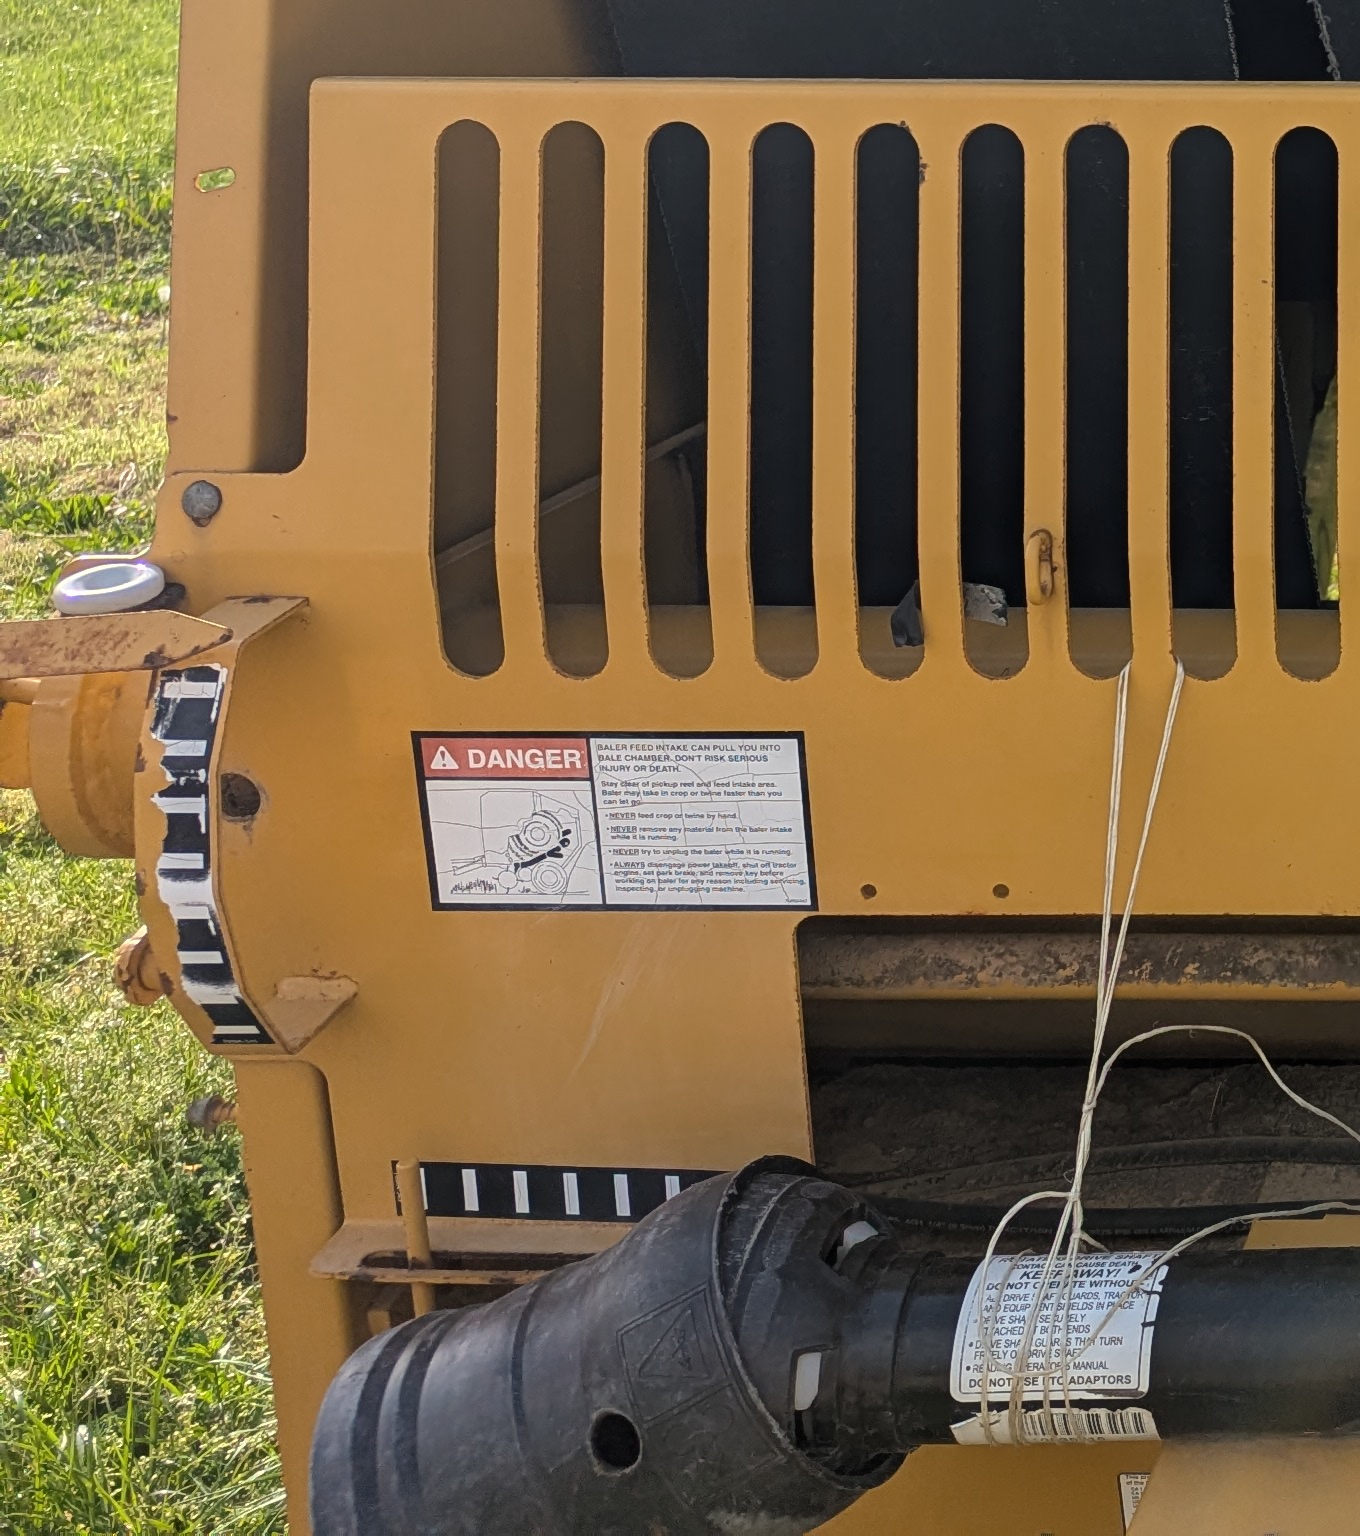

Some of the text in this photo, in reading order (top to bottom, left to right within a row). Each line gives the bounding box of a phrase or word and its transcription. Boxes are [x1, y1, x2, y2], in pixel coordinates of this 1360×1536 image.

[468, 749, 582, 769] DANGER
[1067, 1269, 1121, 1278] AWAY!
[1006, 1282, 1031, 1290] NOT
[1003, 1293, 1030, 1302] DRIVE
[1003, 1302, 1106, 1312] EQUIPENT IN
[1067, 1325, 1090, 1334] ENDS
[1100, 1336, 1123, 1346] TURN
[1073, 1361, 1108, 1370] MANUAL
[989, 1378, 1013, 1387] NOT
[1068, 1375, 1132, 1385] ADAPTORS
